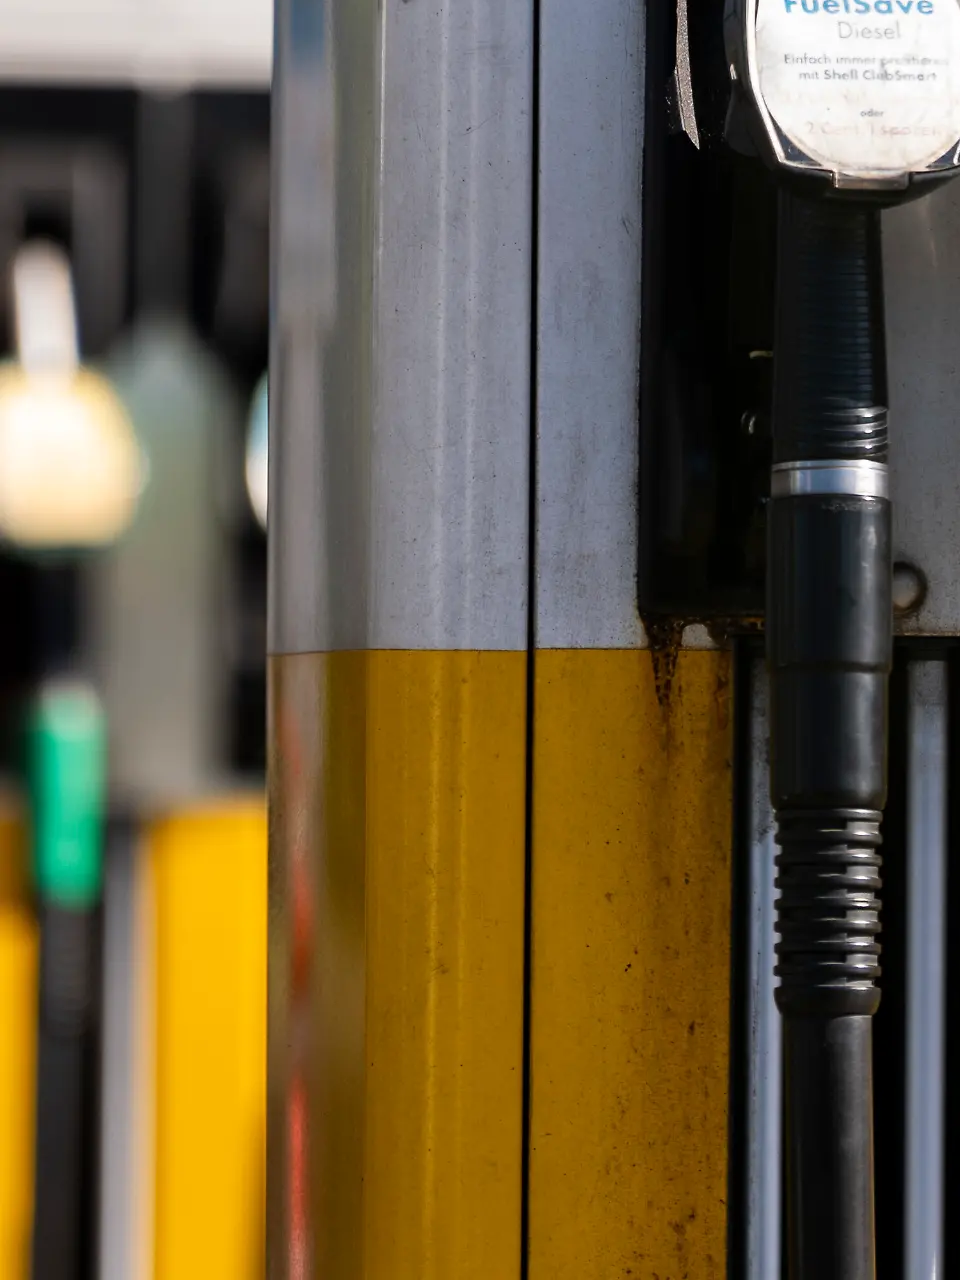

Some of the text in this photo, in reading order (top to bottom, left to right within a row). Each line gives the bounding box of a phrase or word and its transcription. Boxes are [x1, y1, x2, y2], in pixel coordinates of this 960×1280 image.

[837, 20, 902, 40] Diesel
[784, 52, 832, 65] Einfach
[836, 55, 876, 65] immer
[799, 70, 819, 80] mit
[824, 68, 858, 80] Shell
[860, 108, 885, 118] oder
